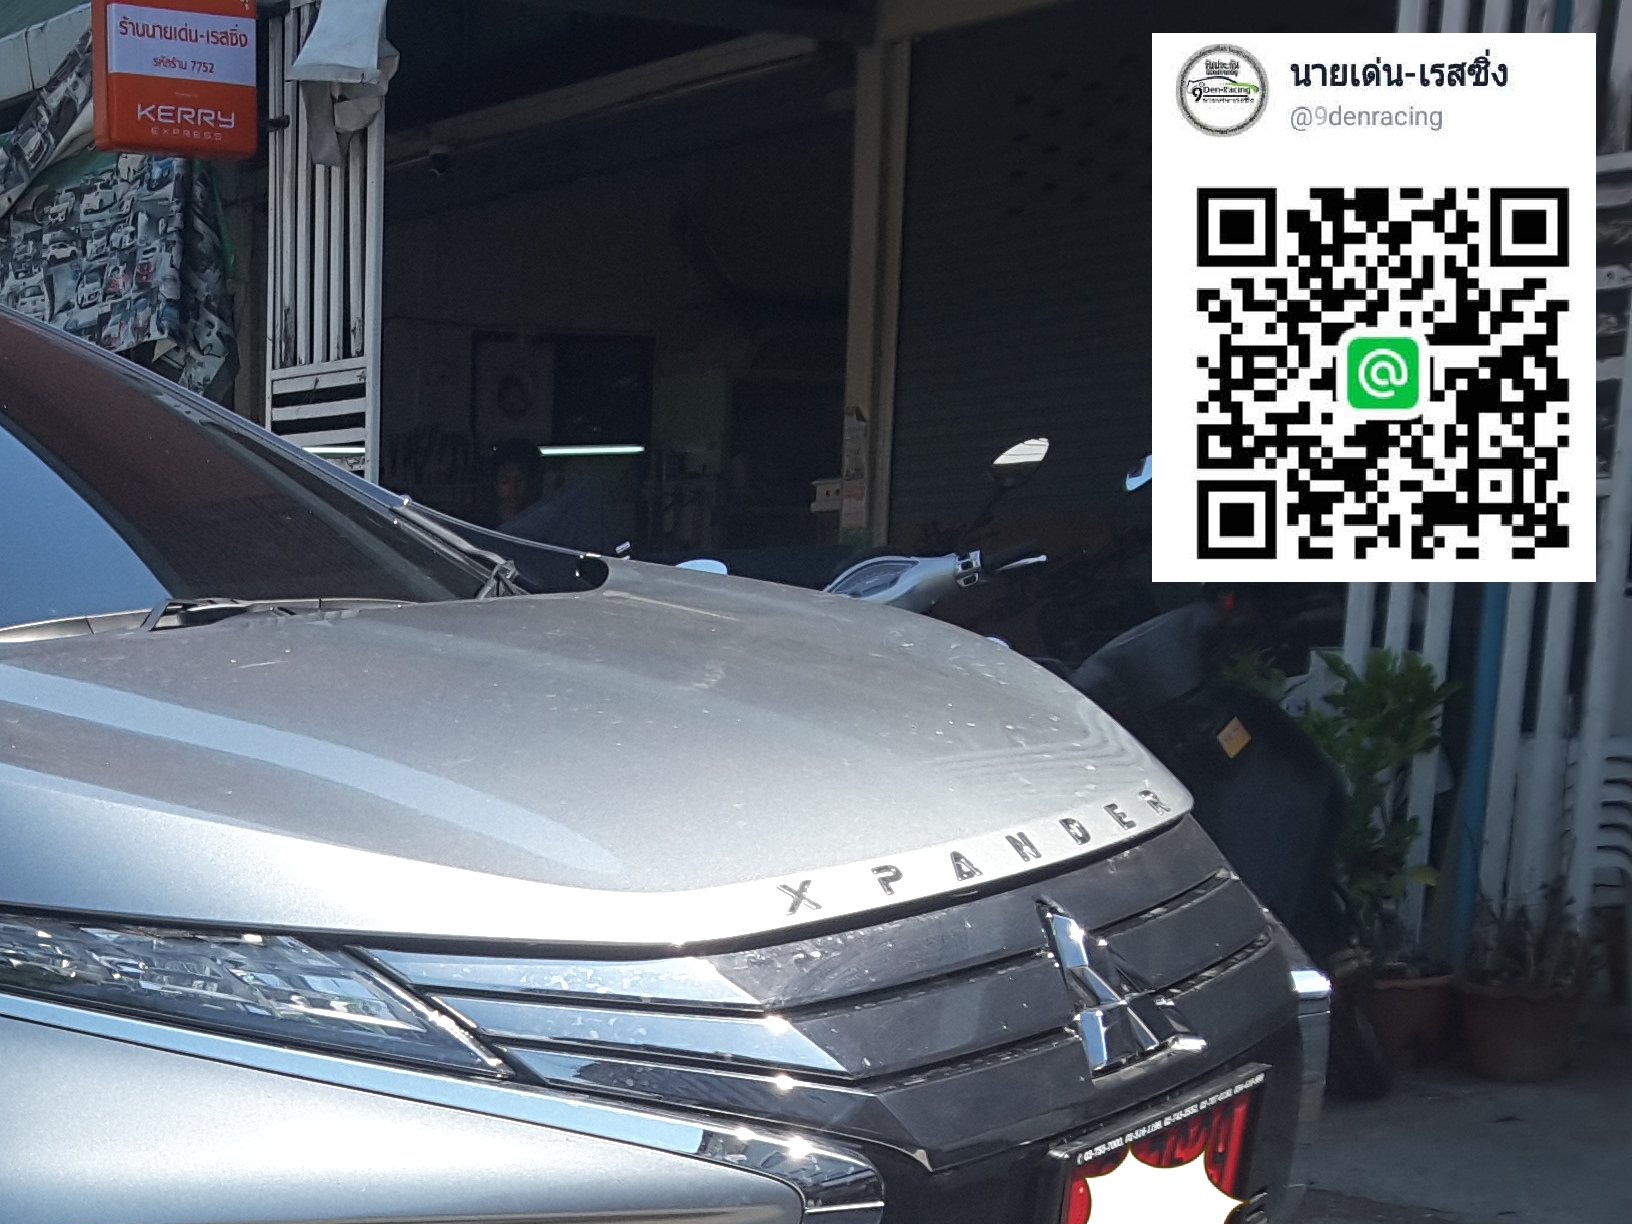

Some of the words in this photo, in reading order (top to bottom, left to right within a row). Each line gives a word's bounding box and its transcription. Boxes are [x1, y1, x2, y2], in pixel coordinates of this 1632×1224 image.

[119, 16, 248, 48] ร้านนายเด่น-เรสซิ่ง
[190, 60, 215, 74] 7752
[137, 103, 235, 129] KERRY
[150, 127, 222, 141] EXPRESS
[777, 789, 1172, 916] XPANDER
